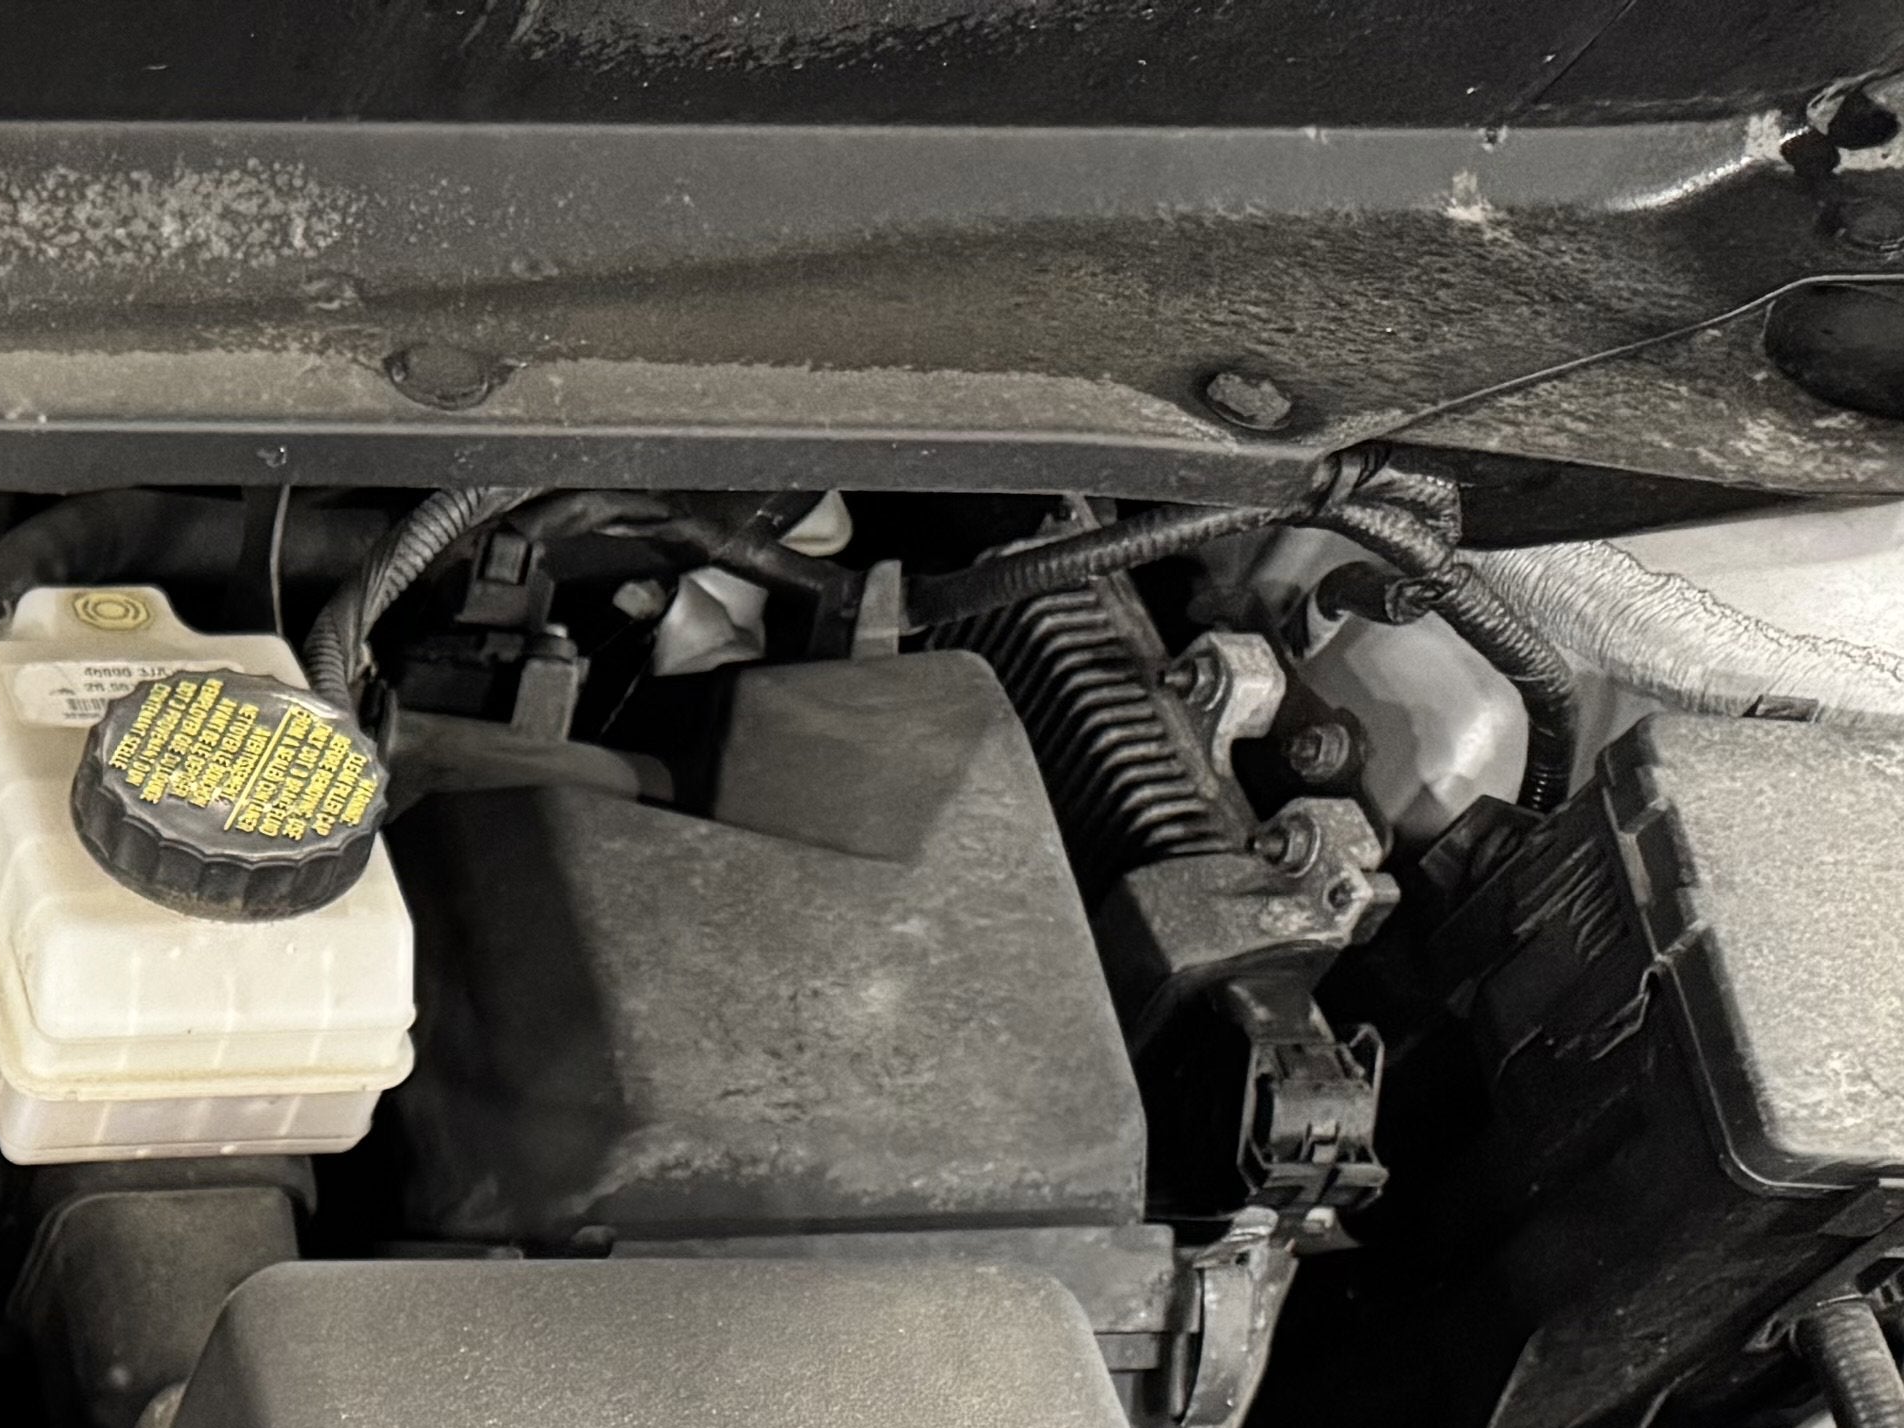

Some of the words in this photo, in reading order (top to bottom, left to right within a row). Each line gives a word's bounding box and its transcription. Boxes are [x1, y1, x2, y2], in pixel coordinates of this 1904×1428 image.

[295, 745, 321, 770] DOT
[318, 732, 352, 773] BEFORE
[311, 812, 336, 836] CAP
